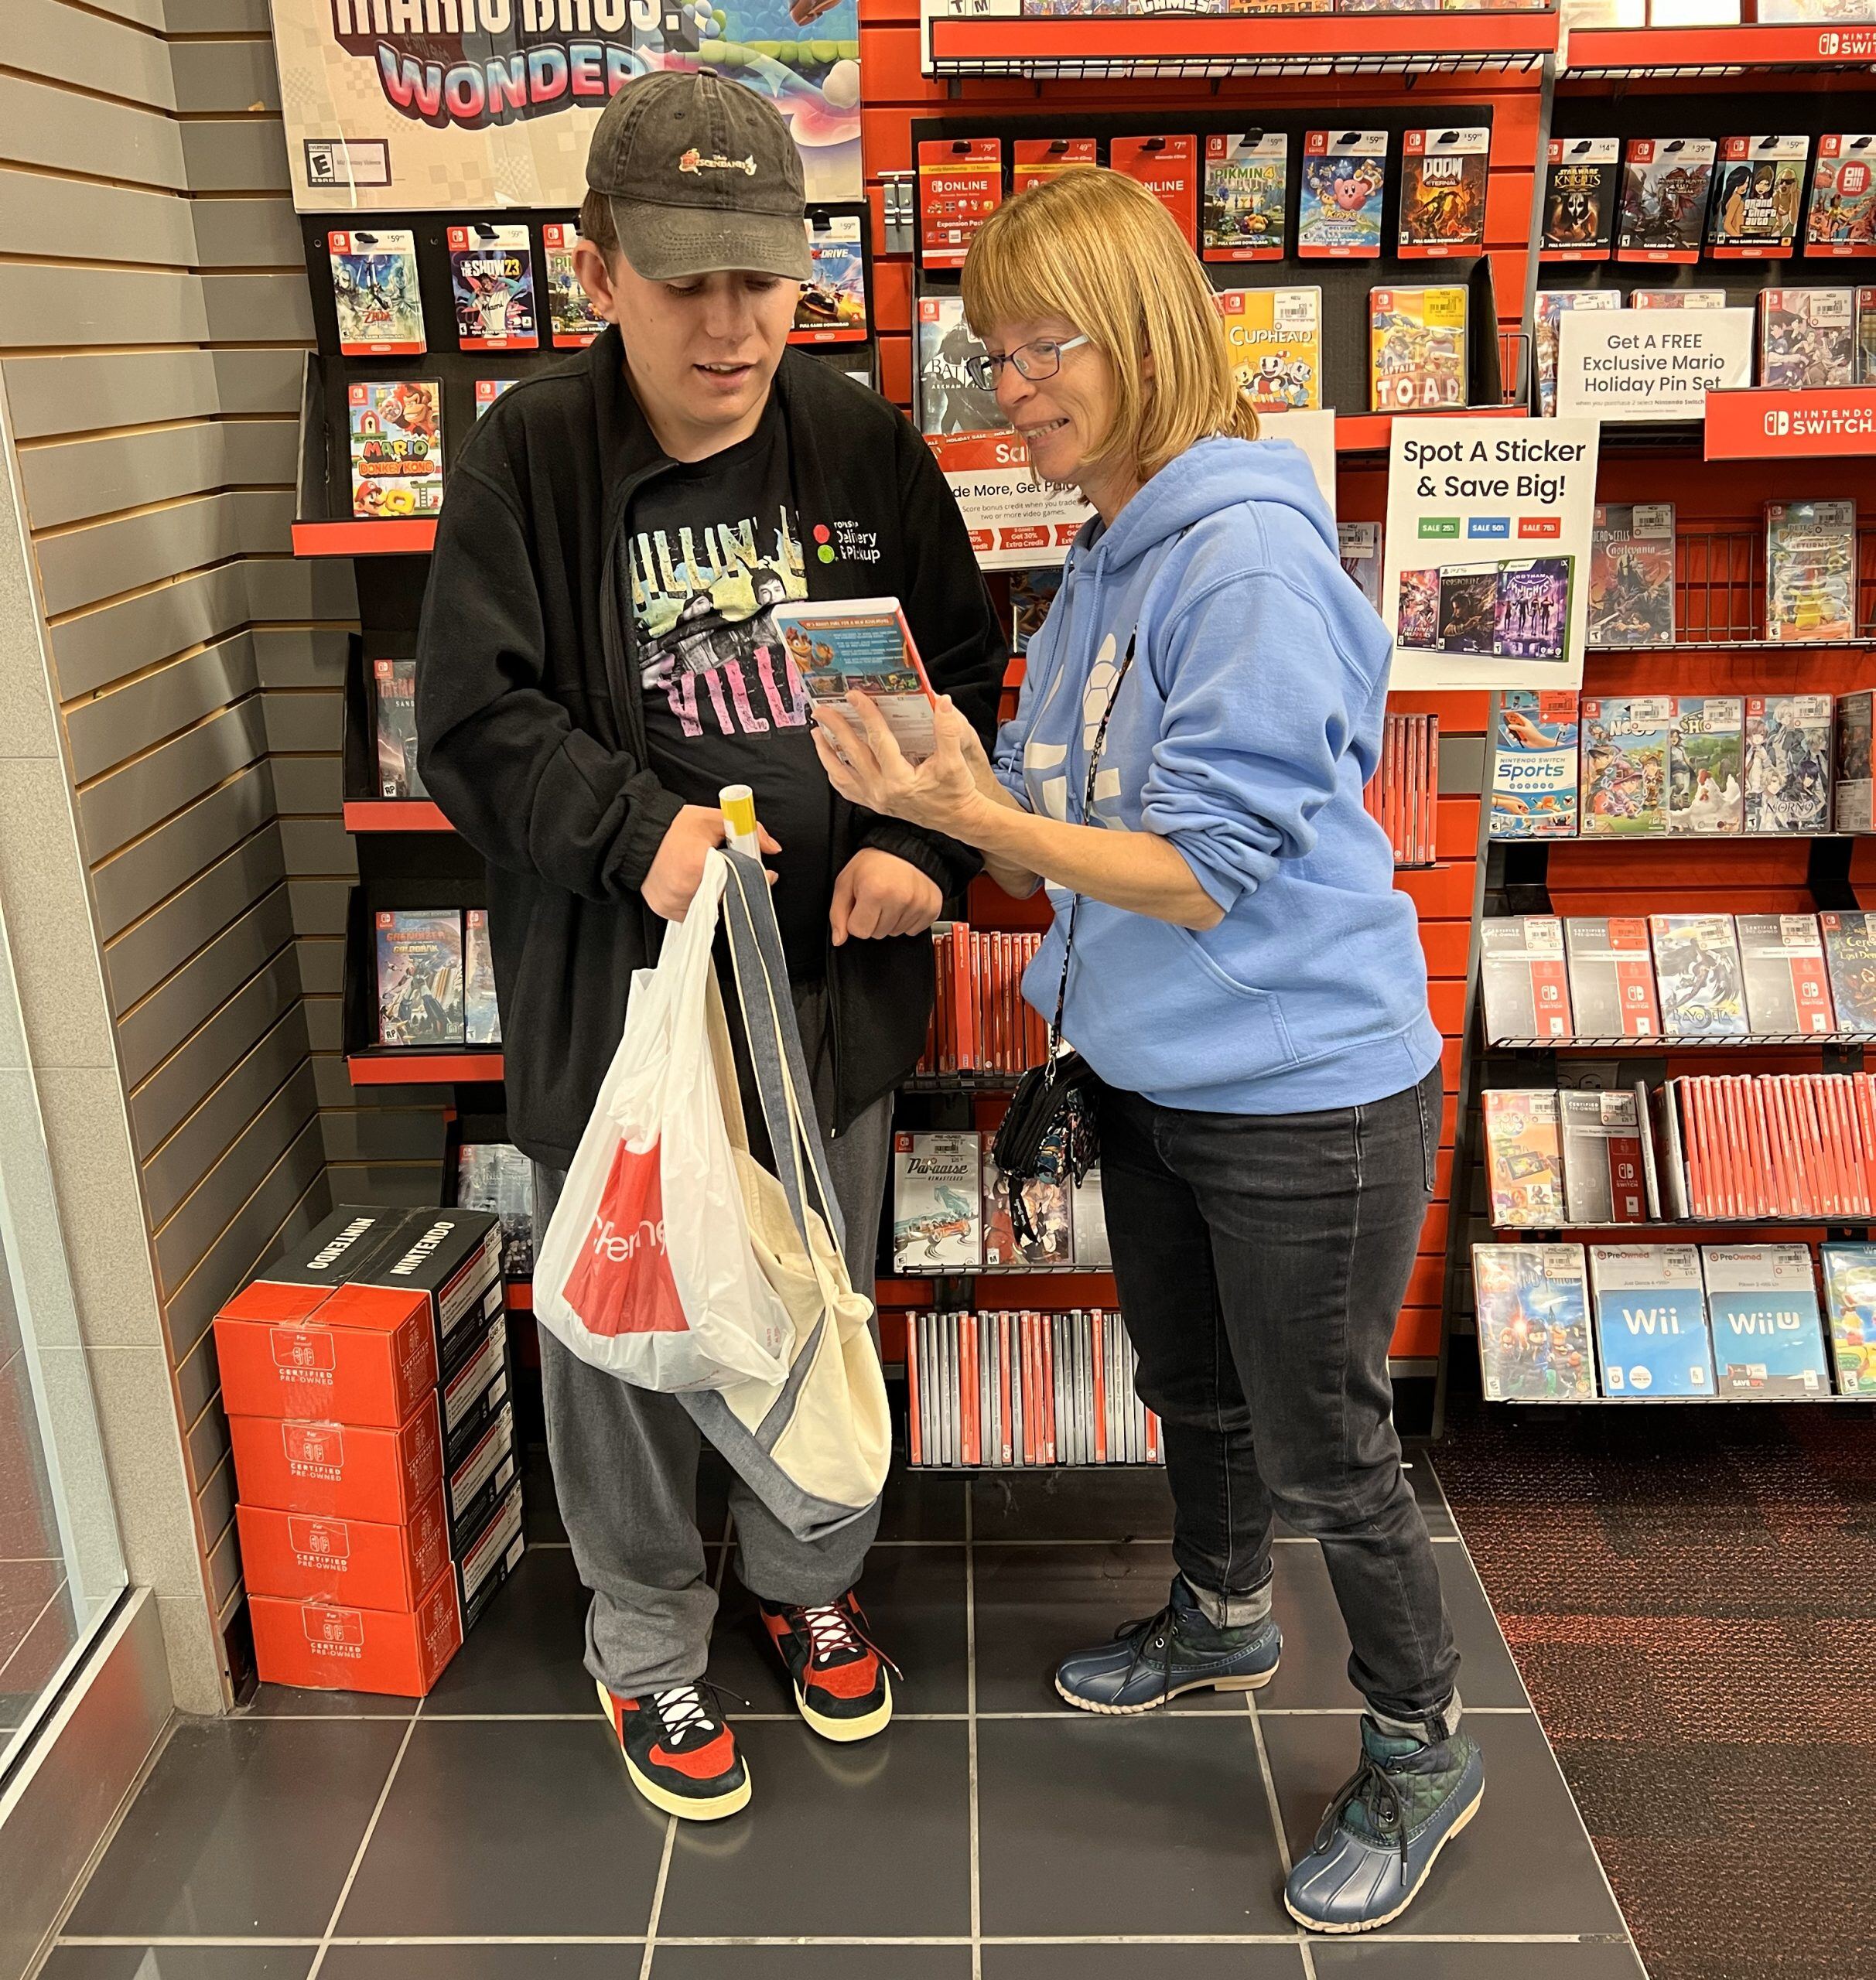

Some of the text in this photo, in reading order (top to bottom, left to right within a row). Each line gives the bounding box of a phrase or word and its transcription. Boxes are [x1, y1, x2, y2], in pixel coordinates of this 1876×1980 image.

[312, 154, 331, 176] E
[1215, 166, 1275, 179] PIKMIN 4
[1423, 157, 1463, 183] DOOM
[944, 181, 989, 191] ONLINE
[821, 249, 849, 258] DRIVE
[504, 259, 521, 276] 23
[1607, 333, 1702, 350] Get A FREE
[1583, 354, 1724, 372] Exclusive Mario
[1376, 377, 1460, 405] TOAD
[1584, 377, 1721, 397] Holiday Pin Set
[1793, 408, 1873, 418] NINTENDO
[1793, 419, 1872, 435] SWITCH
[364, 440, 428, 456] MARIO
[1403, 439, 1586, 469] Spot A Sticker
[359, 460, 435, 475] DONKEY KONG
[974, 484, 1013, 497] More,
[1416, 473, 1566, 504] & Save Big!
[1044, 501, 1058, 510] you
[836, 529, 876, 548] Delivery
[1614, 530, 1630, 542] CELLS
[1512, 582, 1549, 599] KNIGHTS
[1498, 763, 1565, 781] Sports
[307, 1217, 377, 1270] NINTENDO
[389, 1221, 456, 1275] NINTENDO
[1621, 1307, 1680, 1335] Wii
[1727, 1313, 1775, 1335] Wii
[279, 1367, 333, 1378] CERTIFIED
[280, 1374, 333, 1385] PRE-OWNED
[1848, 1377, 1856, 1387] E
[290, 1463, 341, 1476] CERTIFIED
[291, 1470, 342, 1482] PRE-OWNED
[297, 1554, 347, 1566] CERTIFIED
[297, 1561, 347, 1572] PRE-OWNED
[310, 1643, 361, 1653] CERTIFIED
[311, 1648, 362, 1659] PRE-OWNED
